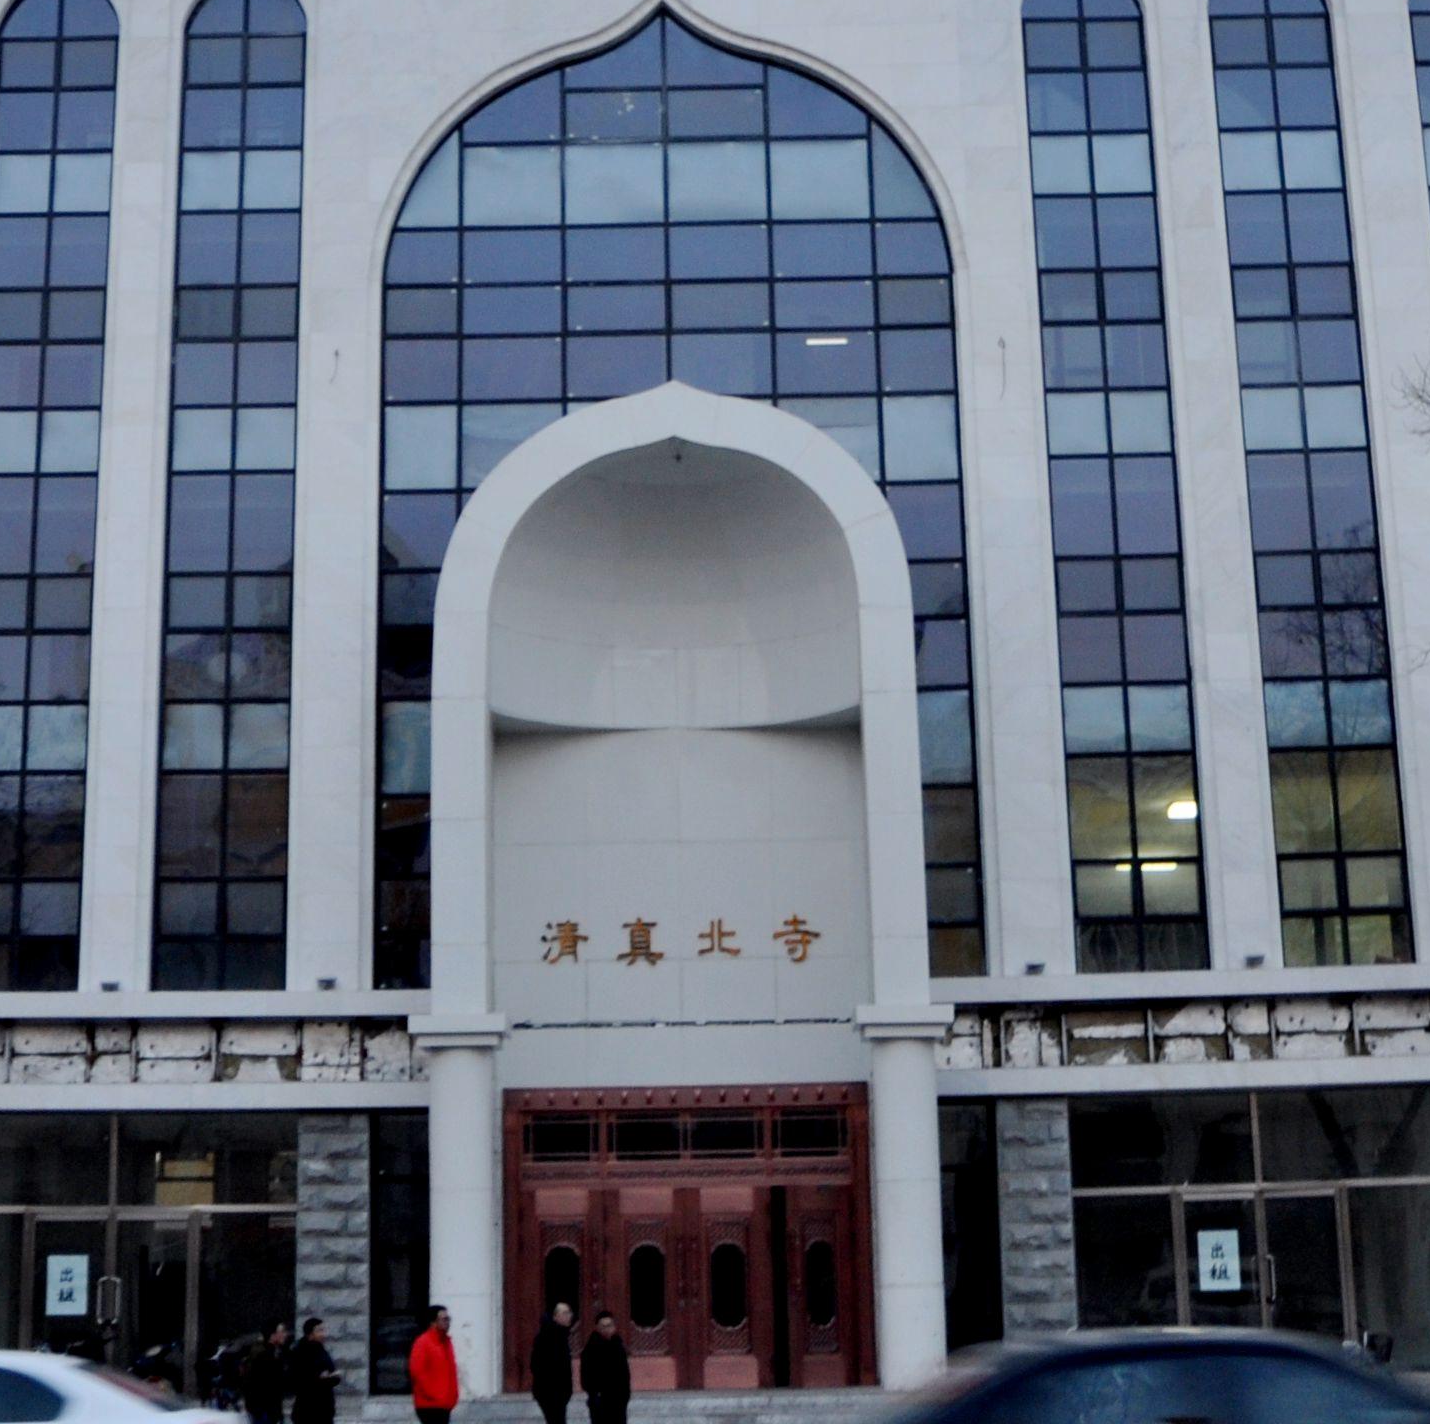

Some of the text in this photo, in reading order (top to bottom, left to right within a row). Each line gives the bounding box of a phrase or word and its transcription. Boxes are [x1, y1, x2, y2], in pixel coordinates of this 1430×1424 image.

[540, 914, 821, 967] 清真北寺
[1209, 1241, 1232, 1280] 出租
[57, 1266, 77, 1304] 出租
